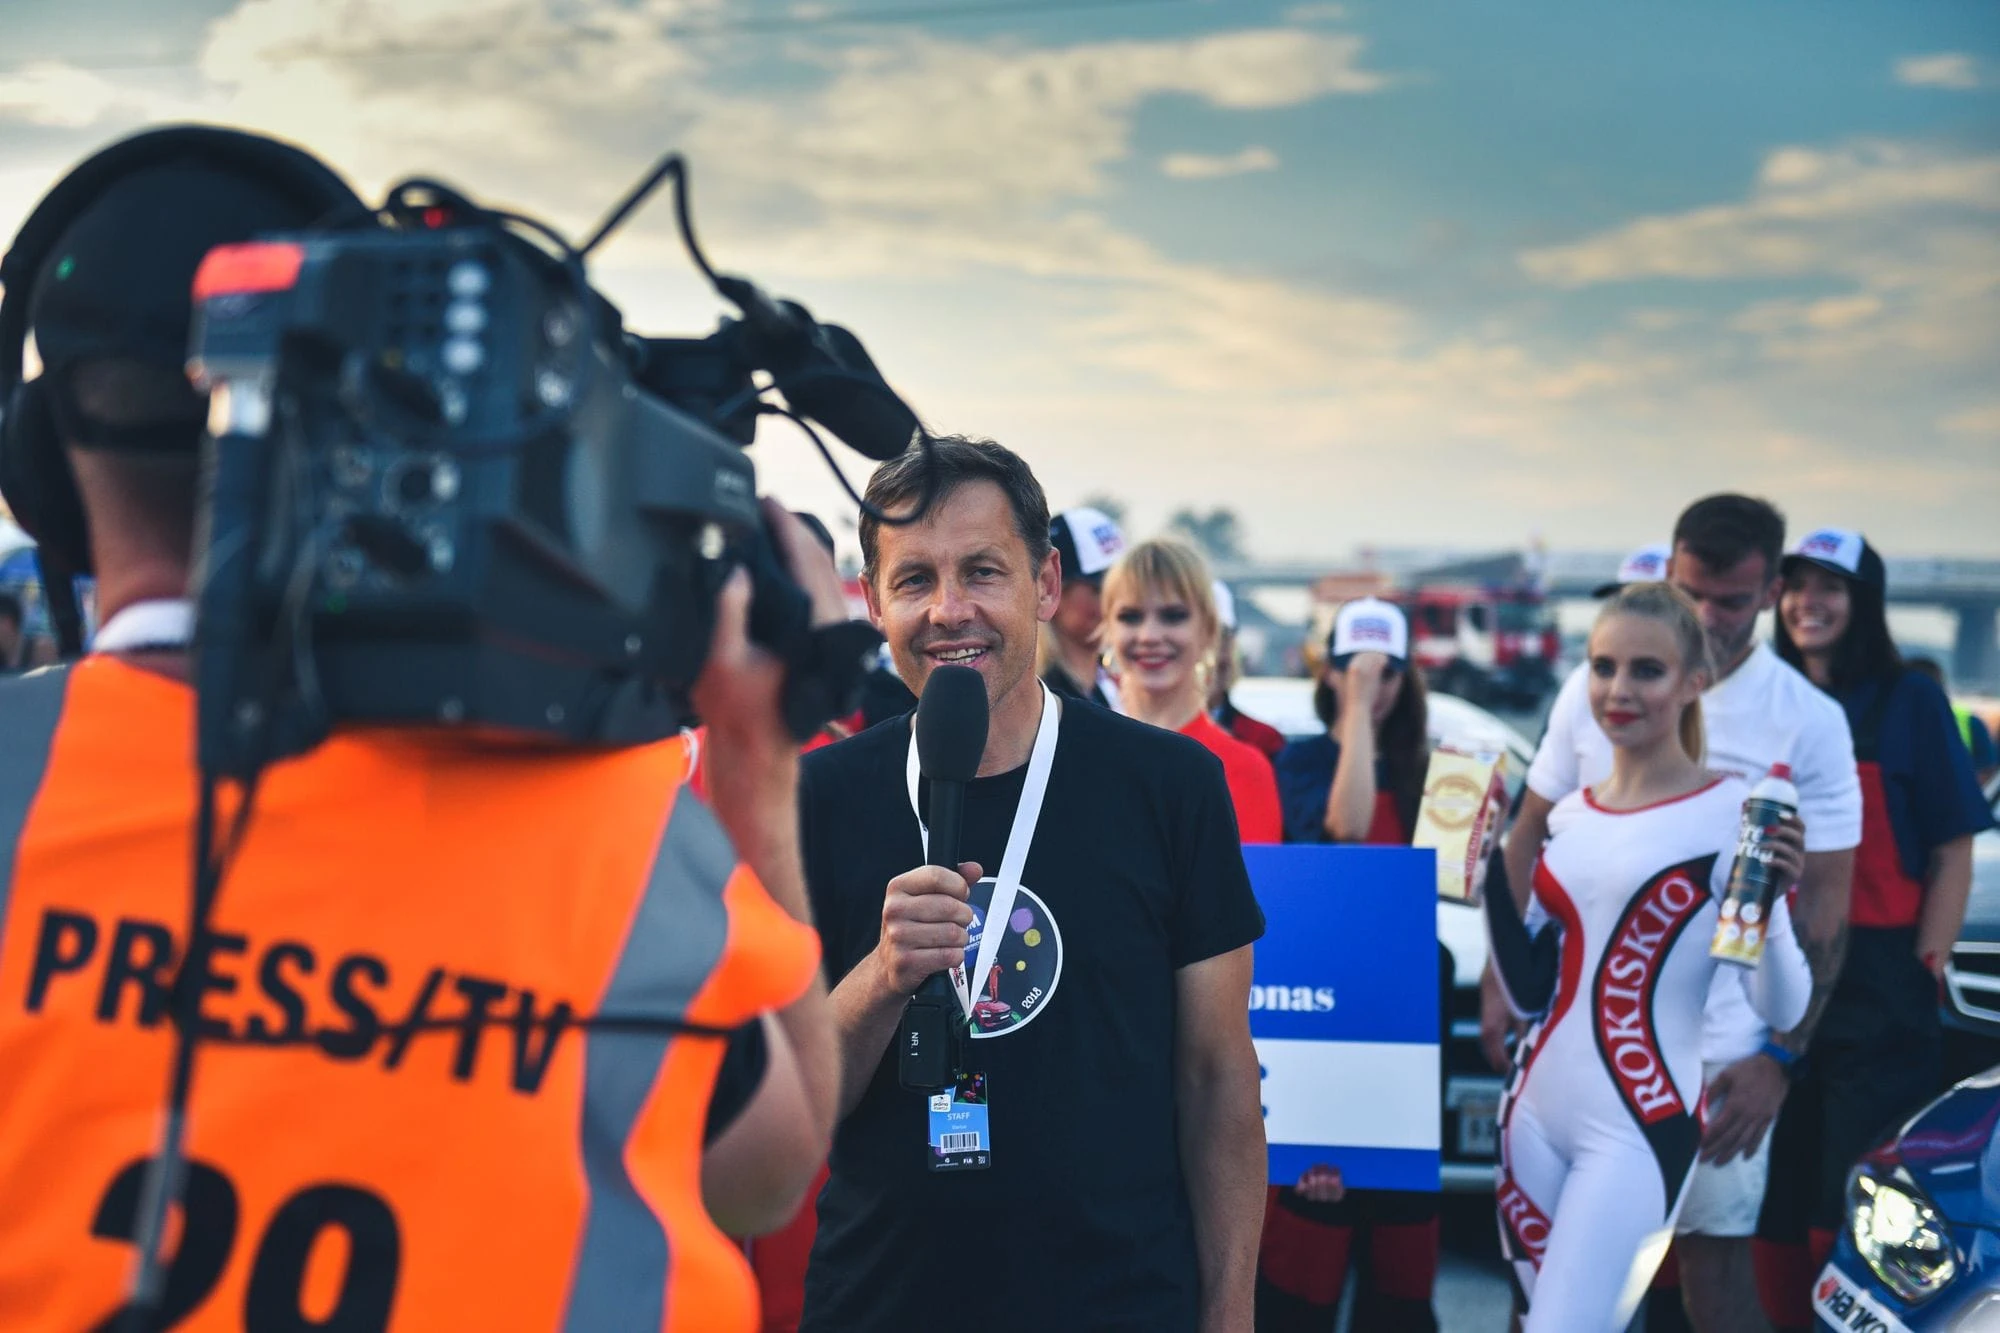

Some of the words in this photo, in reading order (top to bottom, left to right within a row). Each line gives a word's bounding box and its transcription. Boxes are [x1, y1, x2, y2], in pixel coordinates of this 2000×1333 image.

[25, 905, 573, 1095] PRESS/TV
[1021, 986, 1042, 1009] 2018
[1604, 876, 1695, 1115] ROKISKIO
[947, 1112, 970, 1121] STAFF
